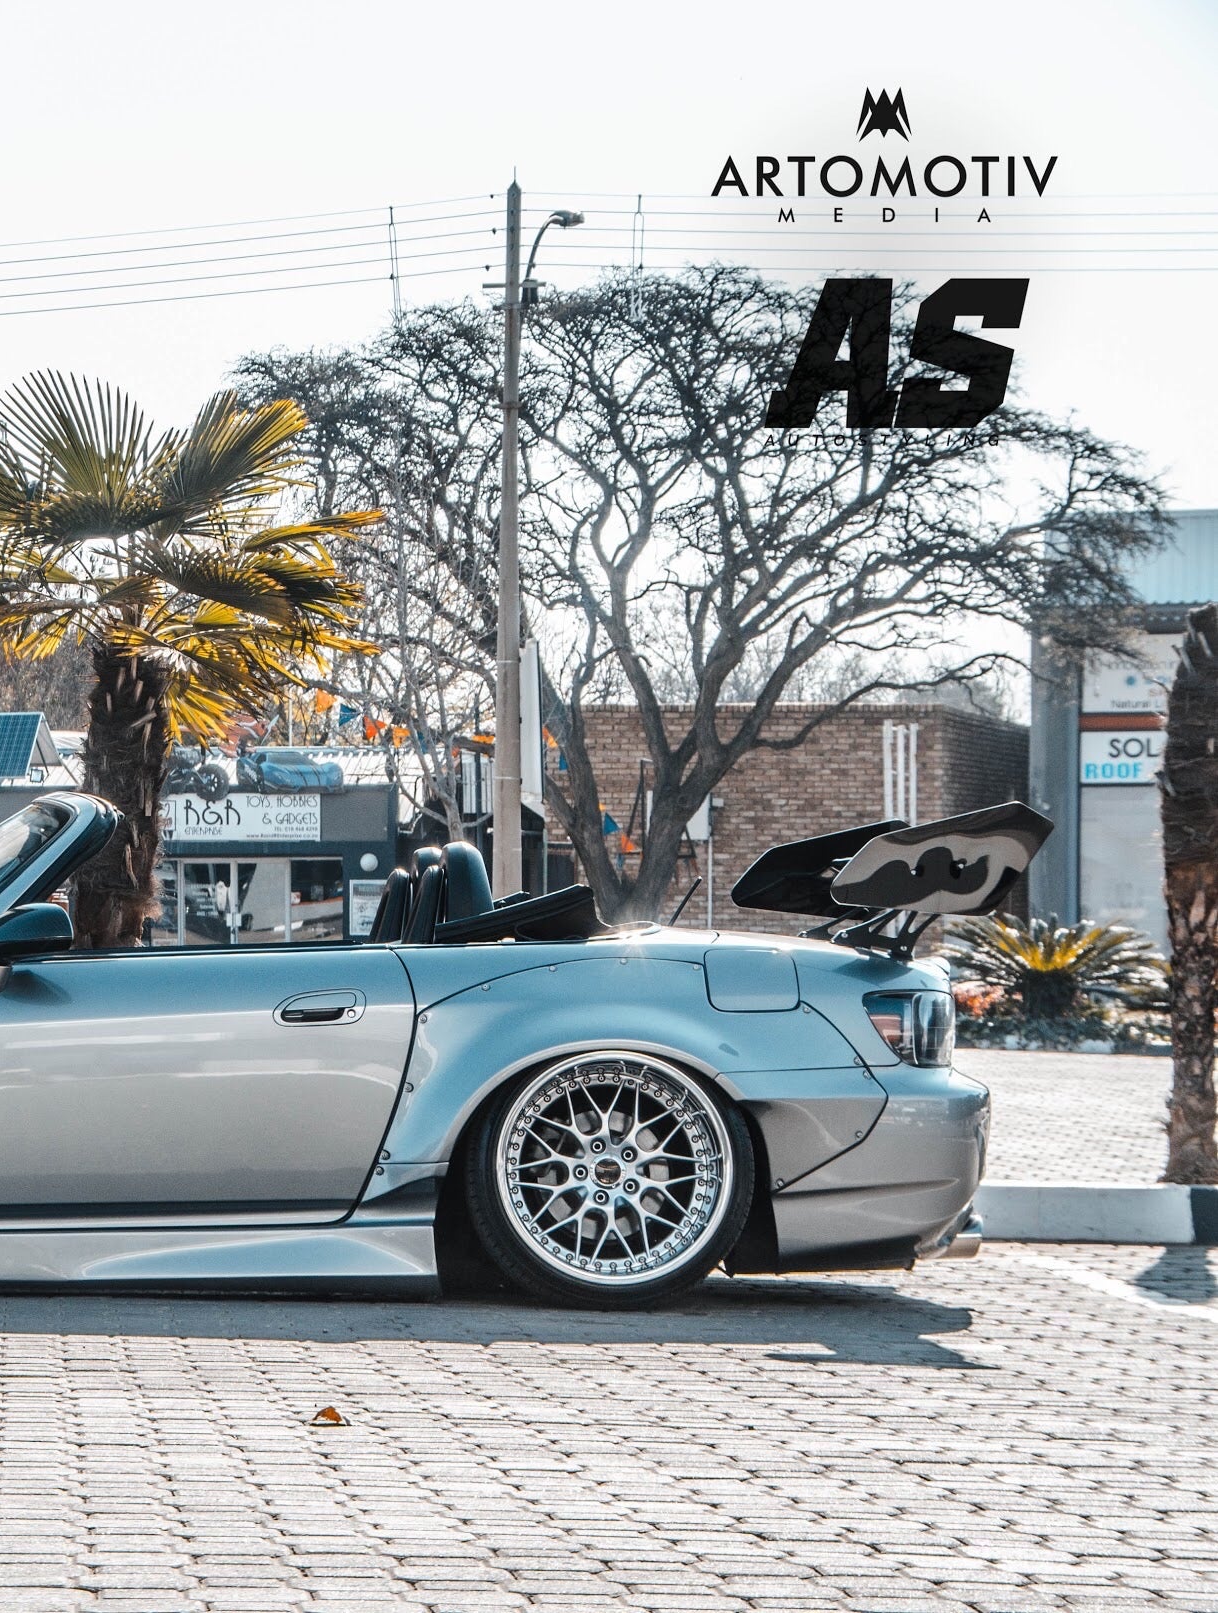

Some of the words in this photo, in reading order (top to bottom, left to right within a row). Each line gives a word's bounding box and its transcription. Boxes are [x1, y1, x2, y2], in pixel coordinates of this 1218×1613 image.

[1085, 763, 1143, 779] ROOF
[183, 798, 241, 826] R&R
[262, 812, 272, 825] &
[275, 812, 318, 825] GADGETS
[184, 826, 223, 836] ENTERPRISE
